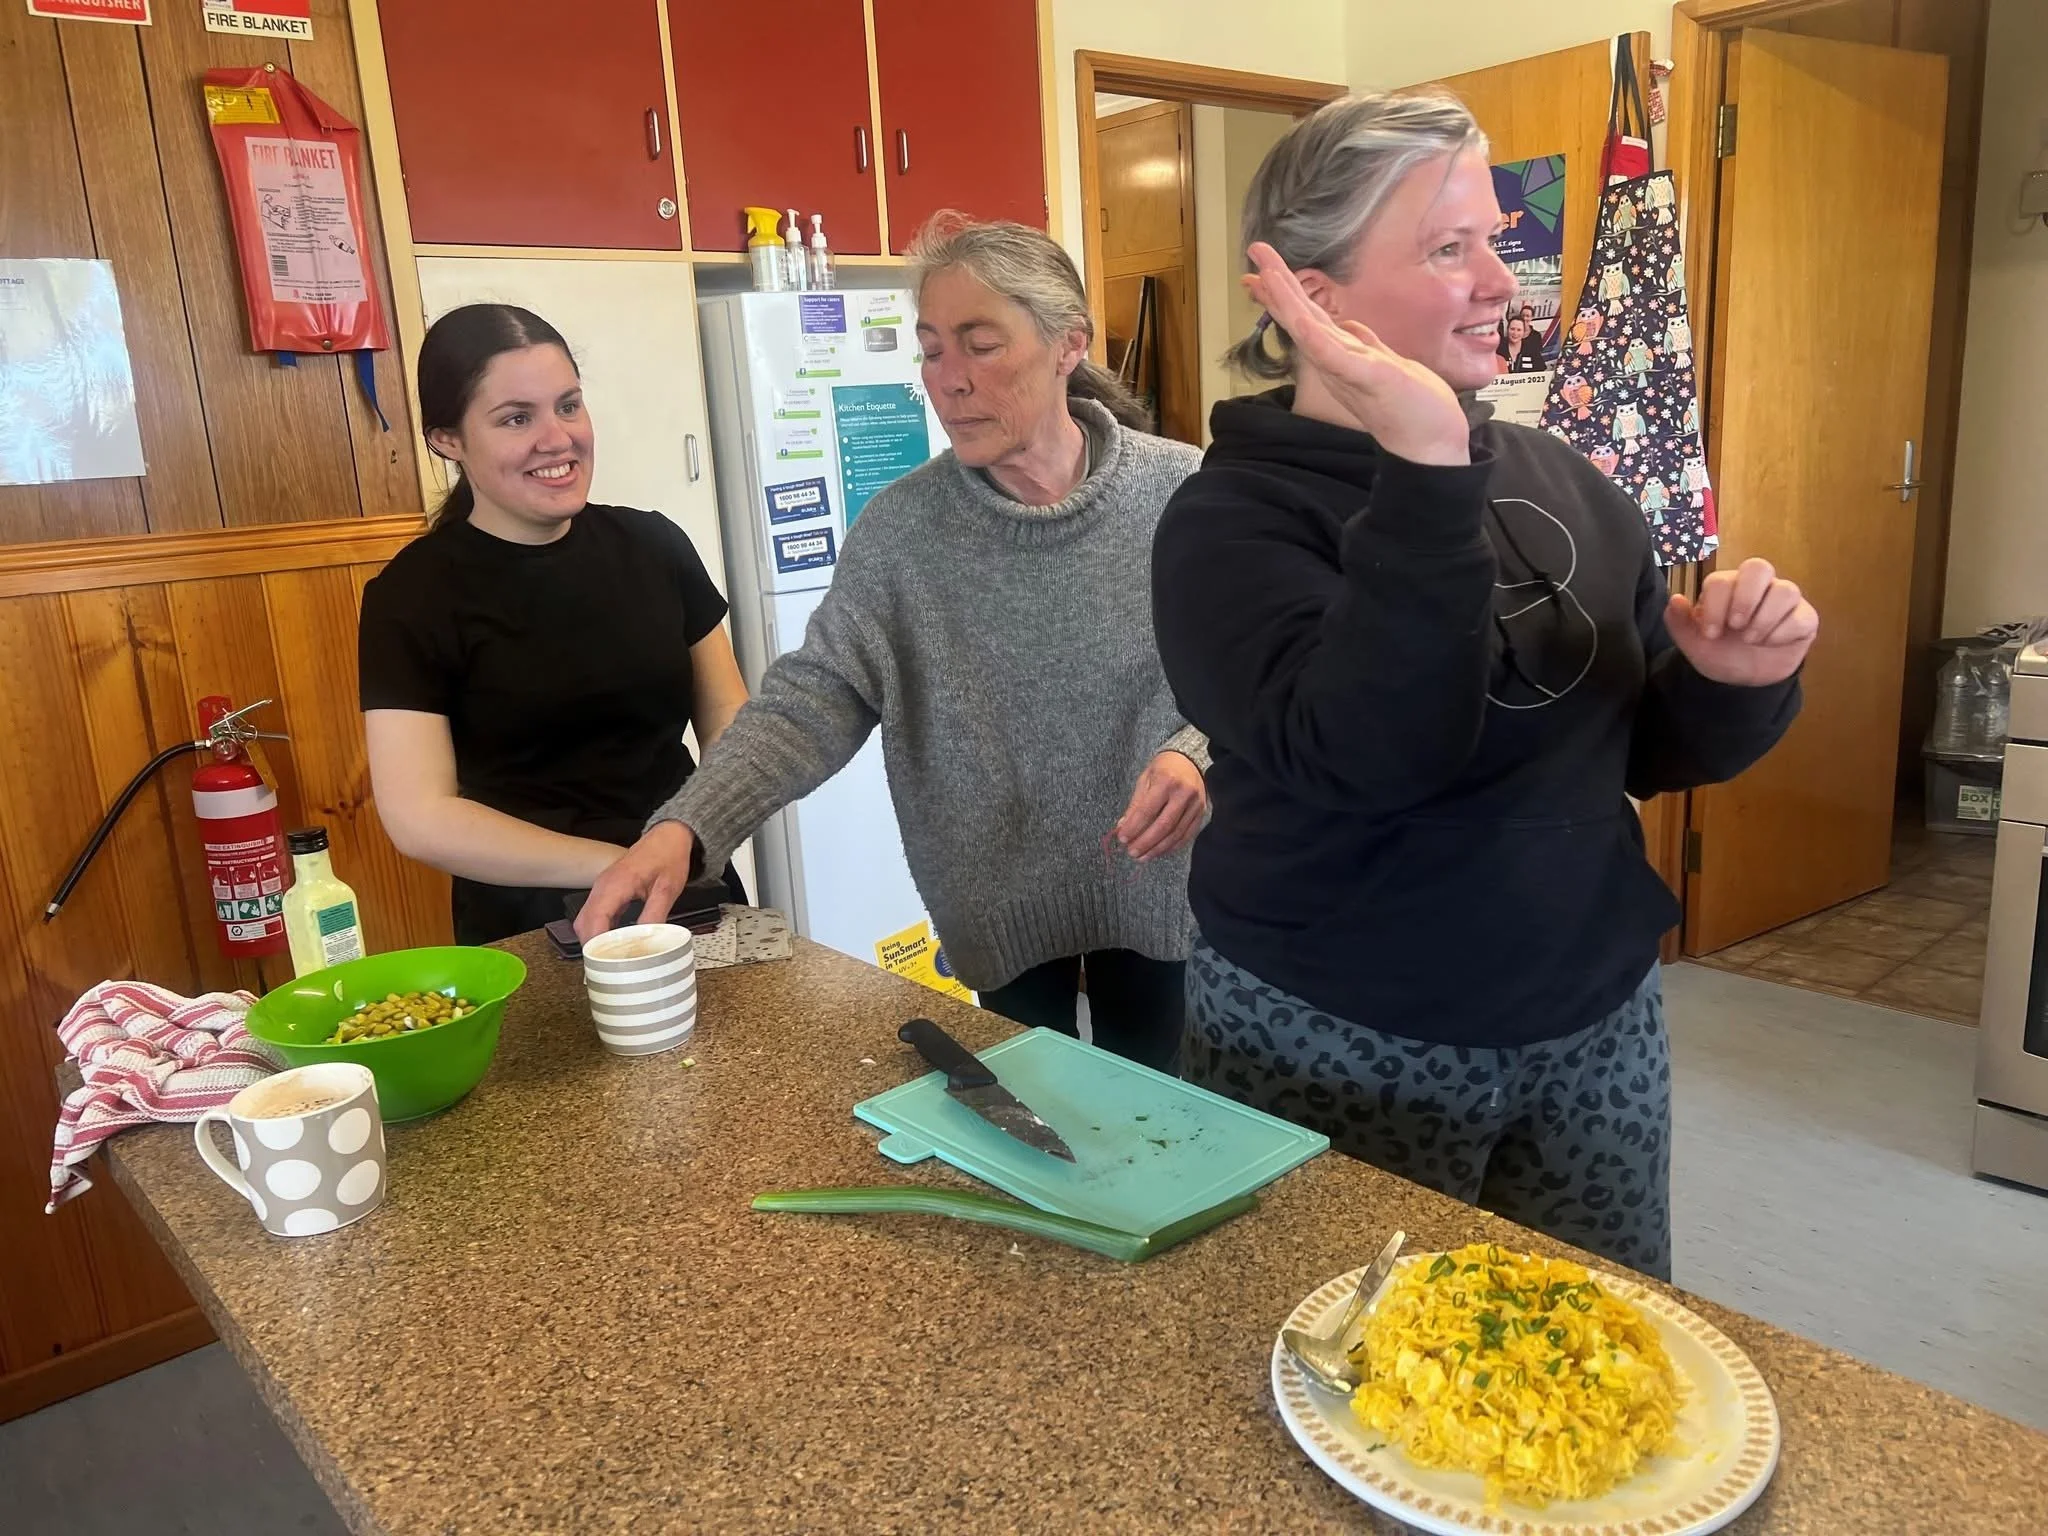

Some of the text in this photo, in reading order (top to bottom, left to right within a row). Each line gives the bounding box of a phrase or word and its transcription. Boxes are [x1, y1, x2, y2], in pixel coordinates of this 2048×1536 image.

[207, 12, 308, 34] FIRE BLANKET
[1500, 378, 1526, 386] August
[839, 402, 896, 413] Kitchen Etiquette
[1961, 793, 1989, 803] BOX
[881, 941, 901, 954] Being
[883, 936, 927, 963] SunSmart
[894, 946, 928, 966] Tasmania
